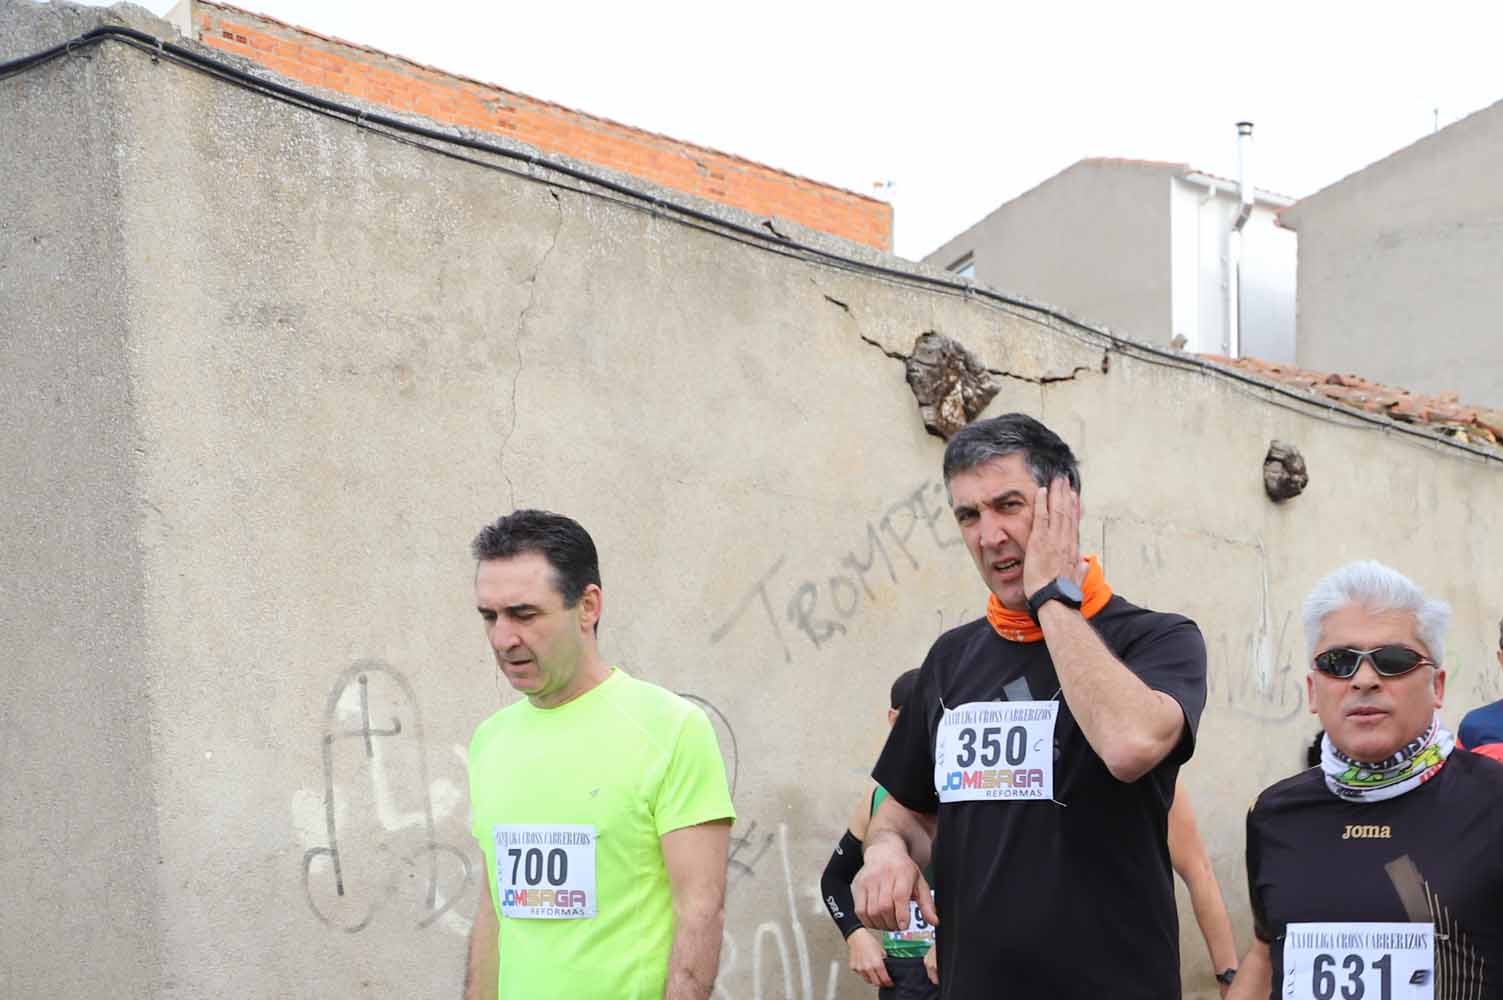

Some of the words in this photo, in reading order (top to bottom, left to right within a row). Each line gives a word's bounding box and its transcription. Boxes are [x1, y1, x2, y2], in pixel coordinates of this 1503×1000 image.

[978, 710, 1003, 724] CROSS
[1004, 708, 1053, 722] CABRERIZOS
[956, 726, 1028, 768] 350
[942, 768, 1044, 791] JOMISAGA
[986, 789, 1043, 798] REFORMAS
[522, 832, 543, 845] CROSS
[508, 848, 568, 886] 700
[1314, 932, 1334, 949] LIGA
[1336, 932, 1364, 949] CROSS
[1365, 931, 1428, 950] CABRERIZOS
